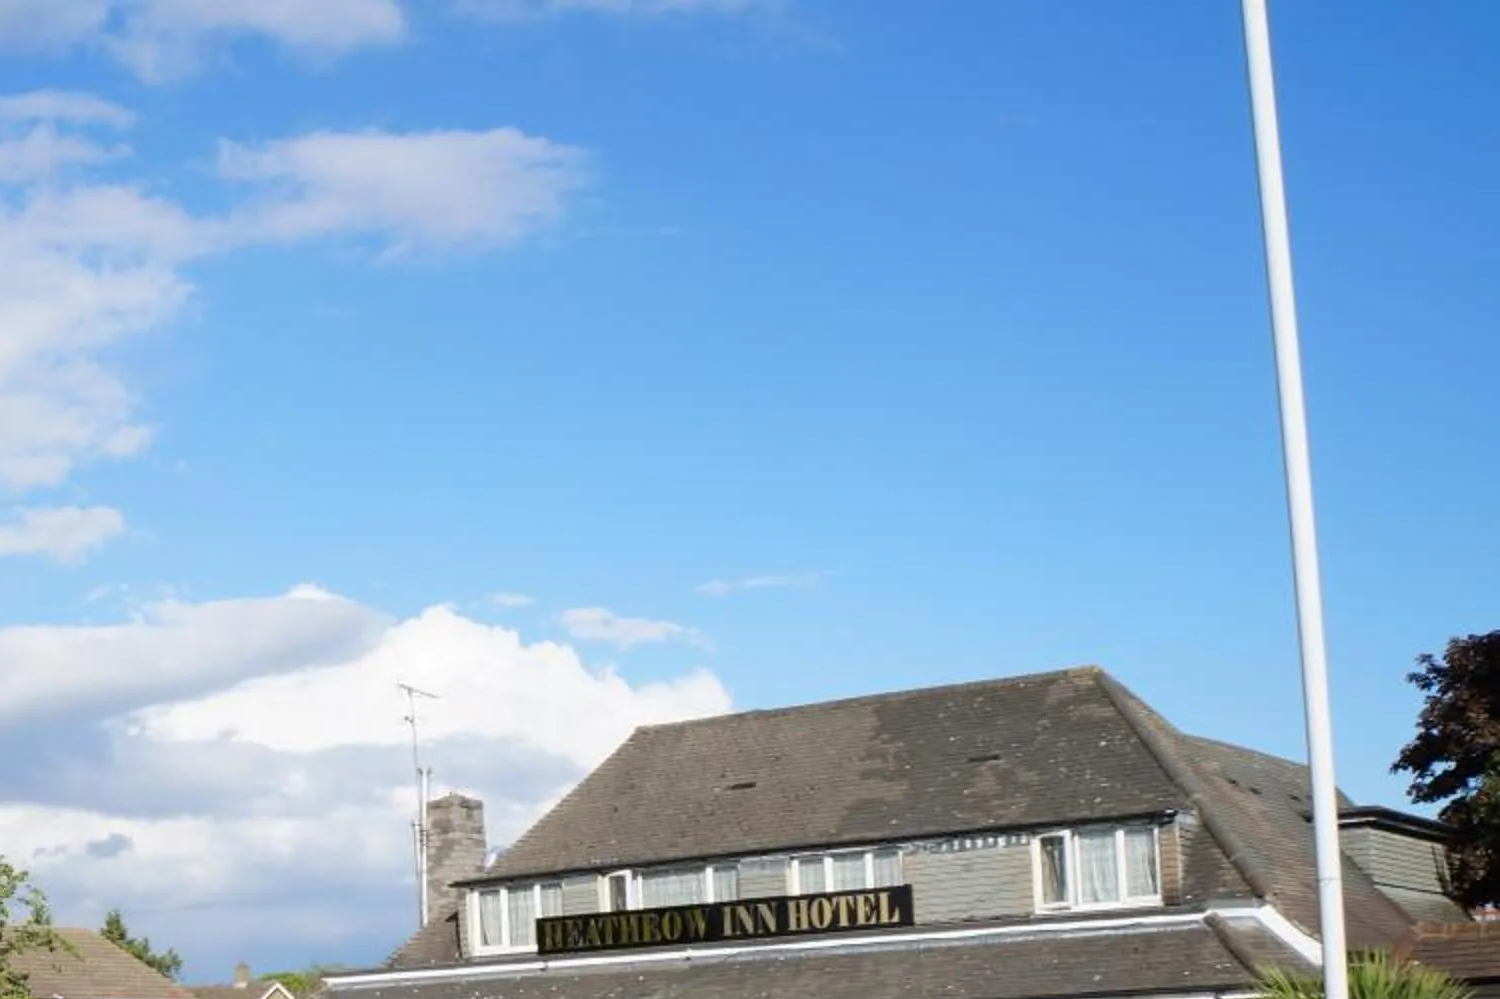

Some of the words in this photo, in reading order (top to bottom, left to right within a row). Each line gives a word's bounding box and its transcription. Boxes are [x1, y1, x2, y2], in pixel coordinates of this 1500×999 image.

[543, 908, 708, 950] HEATHROW
[722, 901, 778, 937] INN
[787, 891, 901, 931] HOTEL
